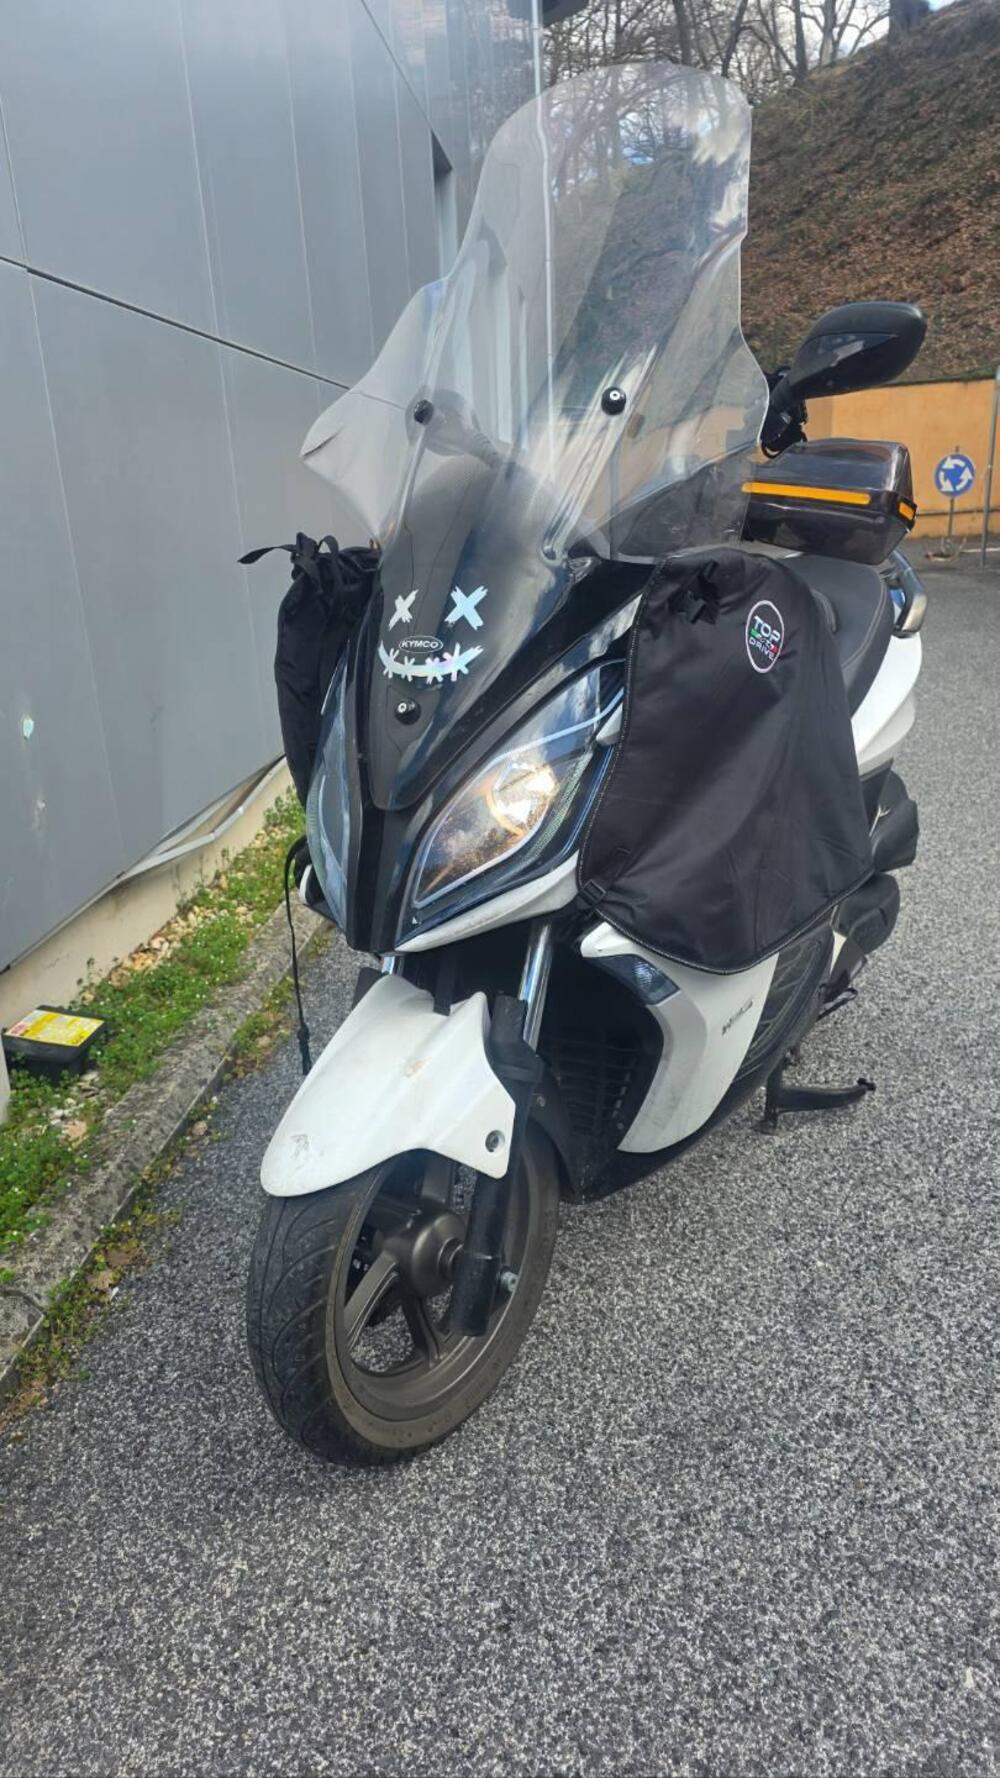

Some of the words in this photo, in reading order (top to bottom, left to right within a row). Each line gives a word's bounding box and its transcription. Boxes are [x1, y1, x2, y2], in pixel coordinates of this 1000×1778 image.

[753, 615, 781, 642] TOP
[401, 640, 439, 649] KYMCO
[749, 637, 775, 661] DRIVE
